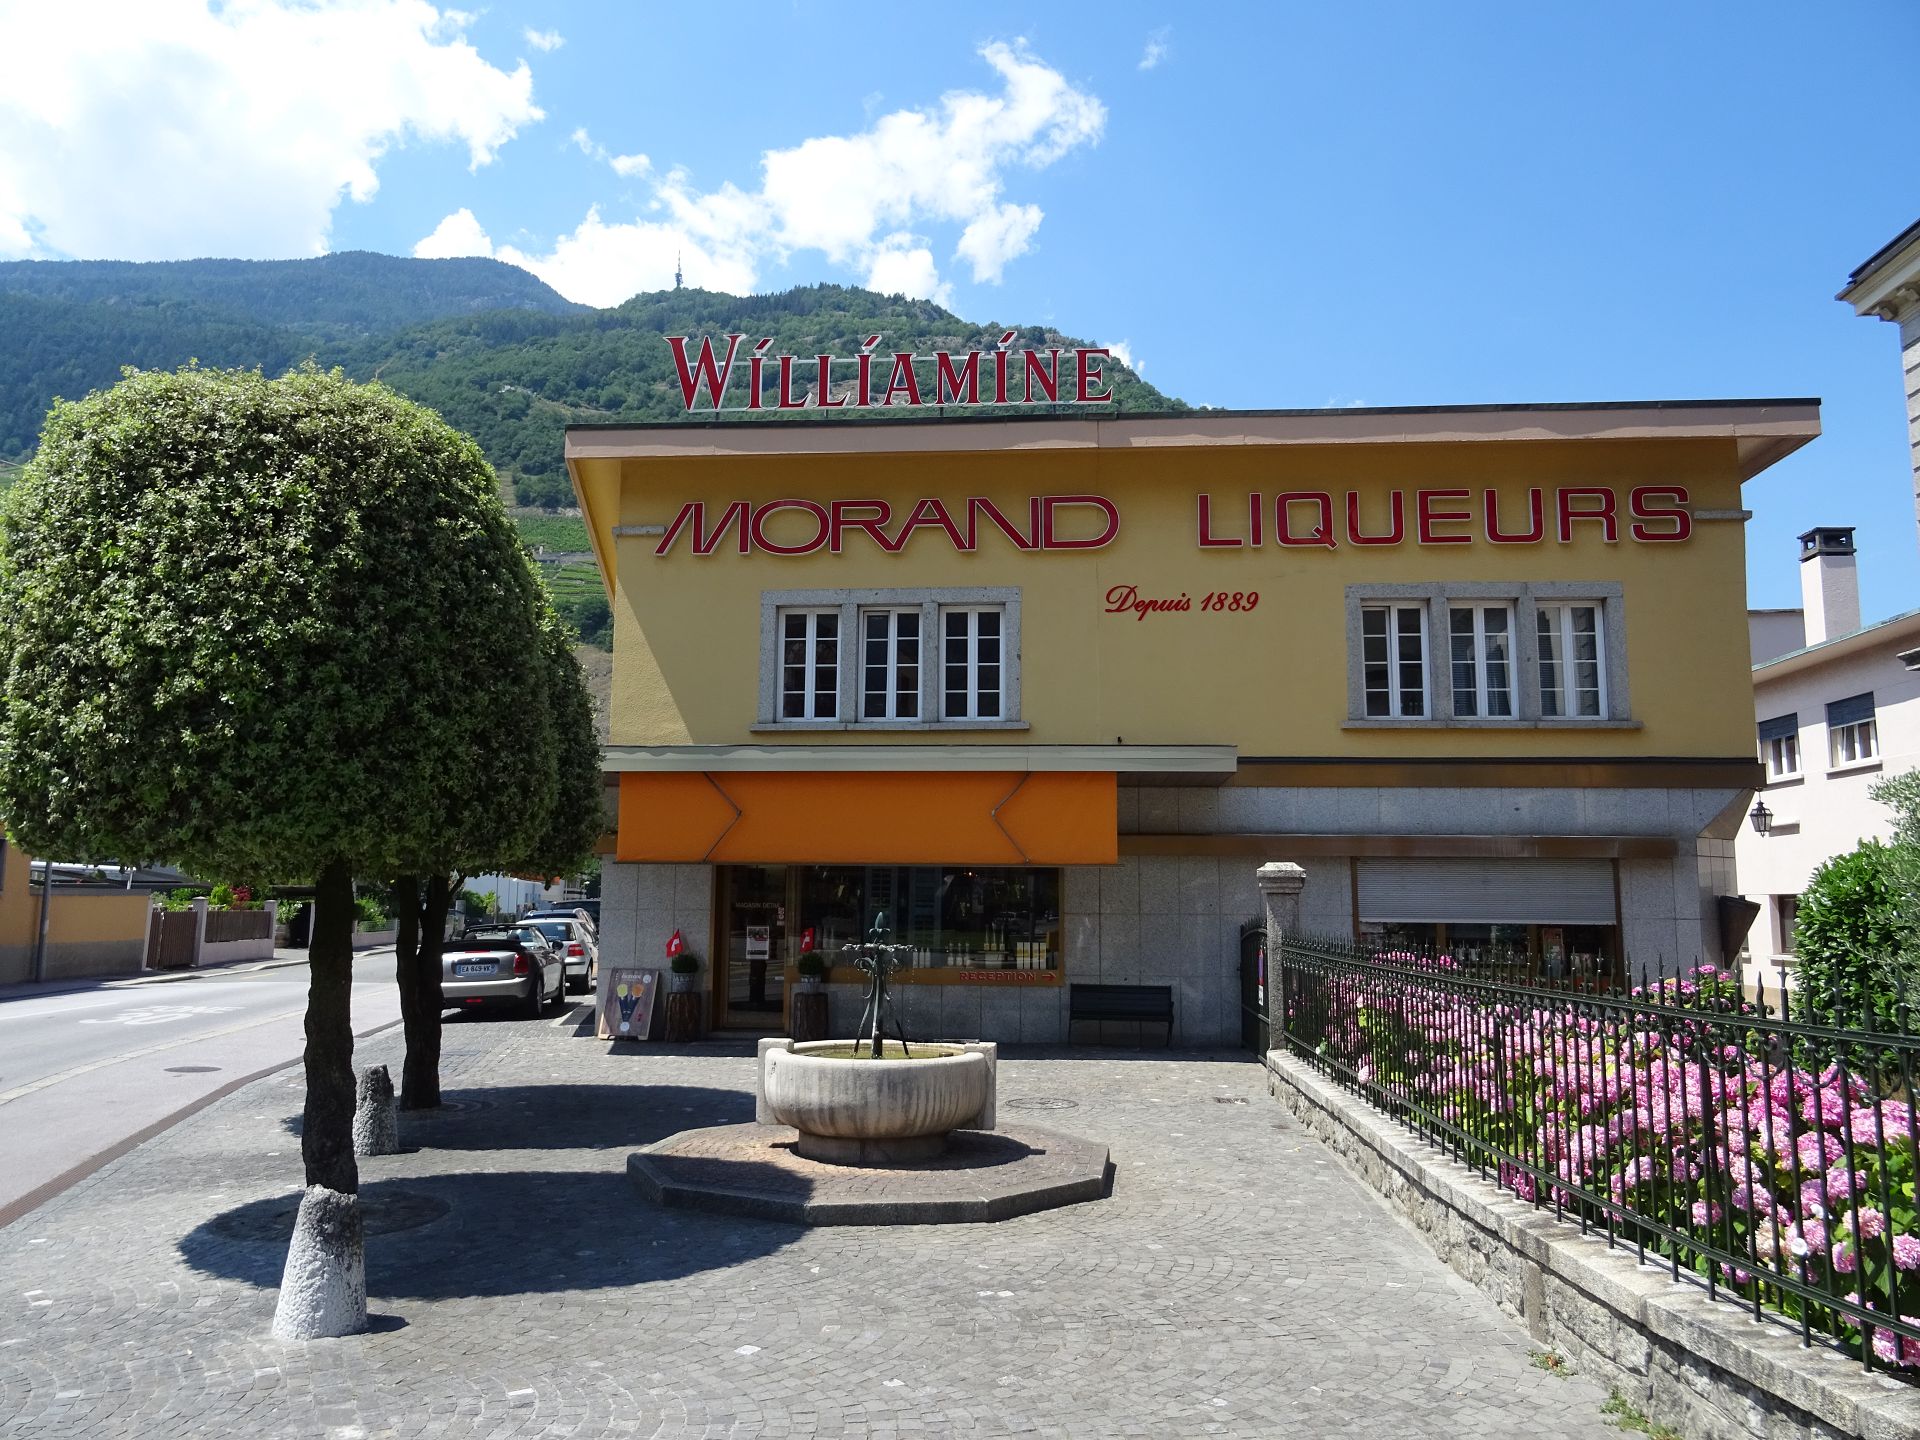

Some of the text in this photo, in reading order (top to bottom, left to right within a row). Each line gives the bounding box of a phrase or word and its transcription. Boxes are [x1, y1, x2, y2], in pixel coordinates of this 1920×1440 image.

[654, 486, 1693, 557] MORAND LIQUEURS
[1104, 585, 1260, 622] Depuis 1889
[960, 971, 1036, 981] RECEPTION
